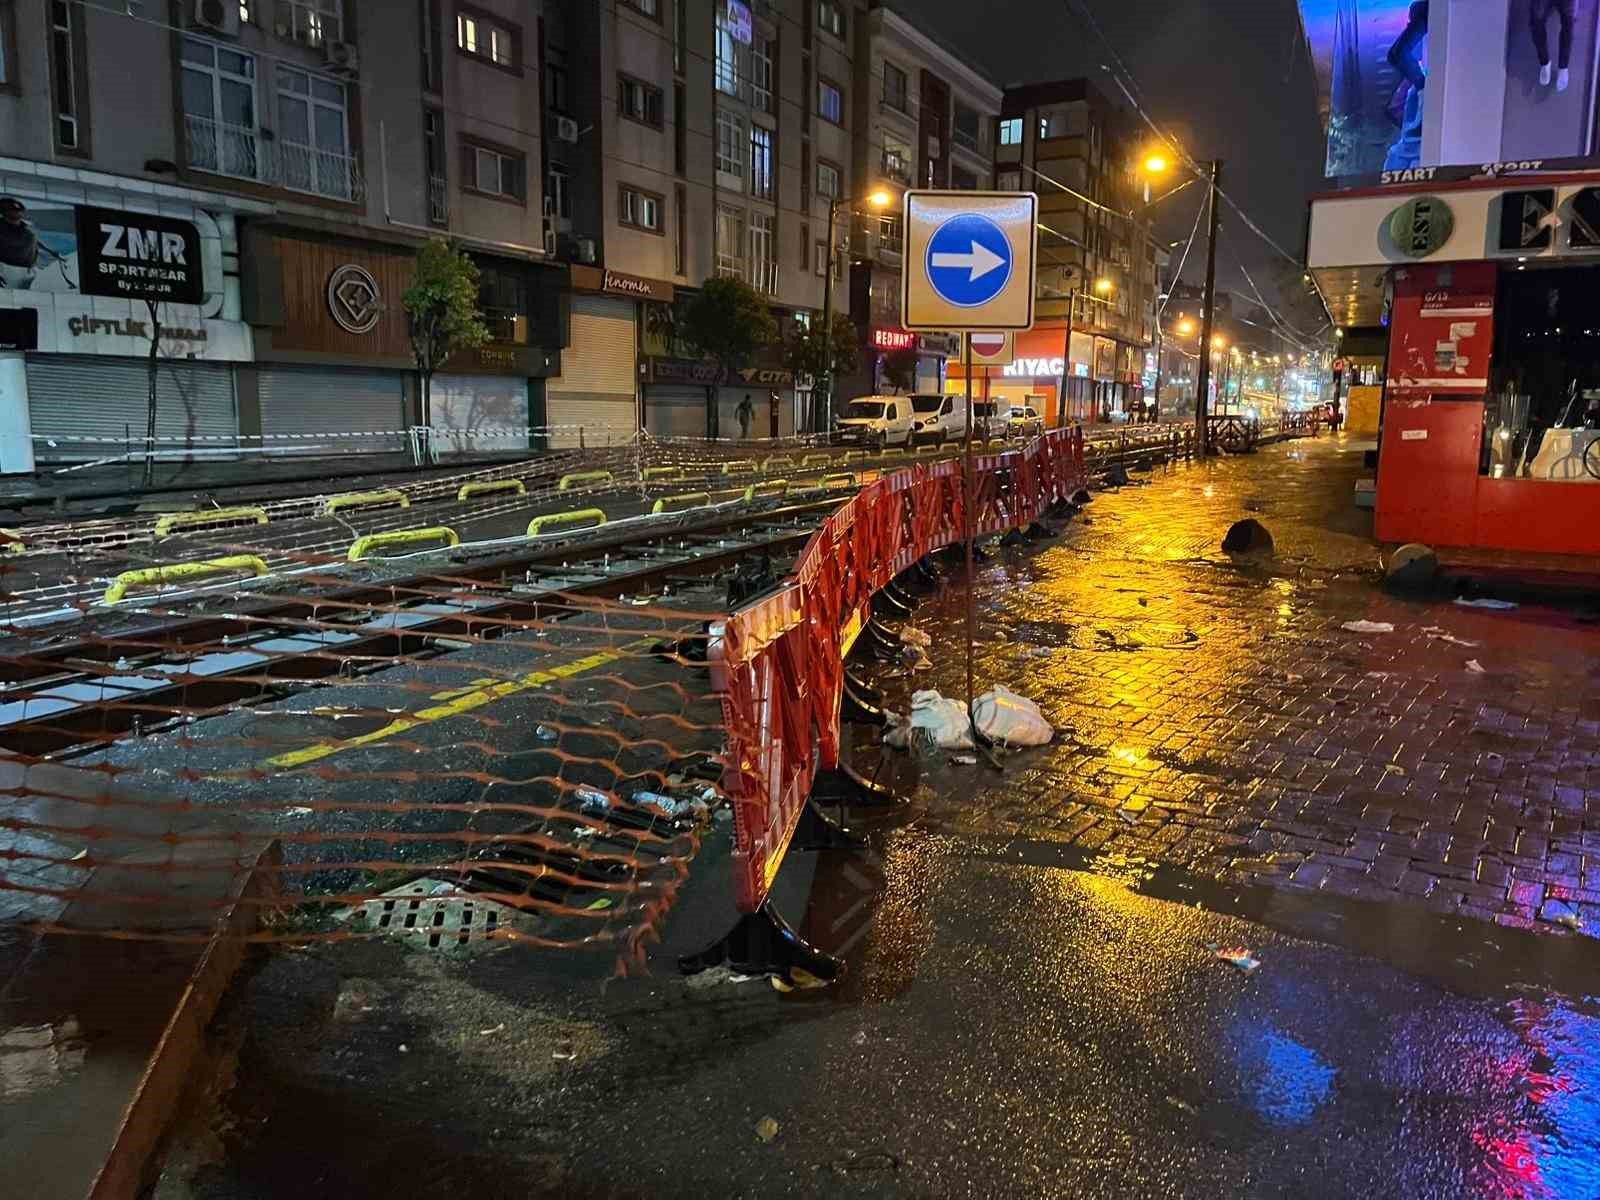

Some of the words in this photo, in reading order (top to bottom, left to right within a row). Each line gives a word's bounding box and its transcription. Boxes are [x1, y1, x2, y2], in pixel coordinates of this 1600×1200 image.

[1381, 167, 1436, 184] START
[99, 223, 188, 265] ZMR
[118, 280, 132, 292] By
